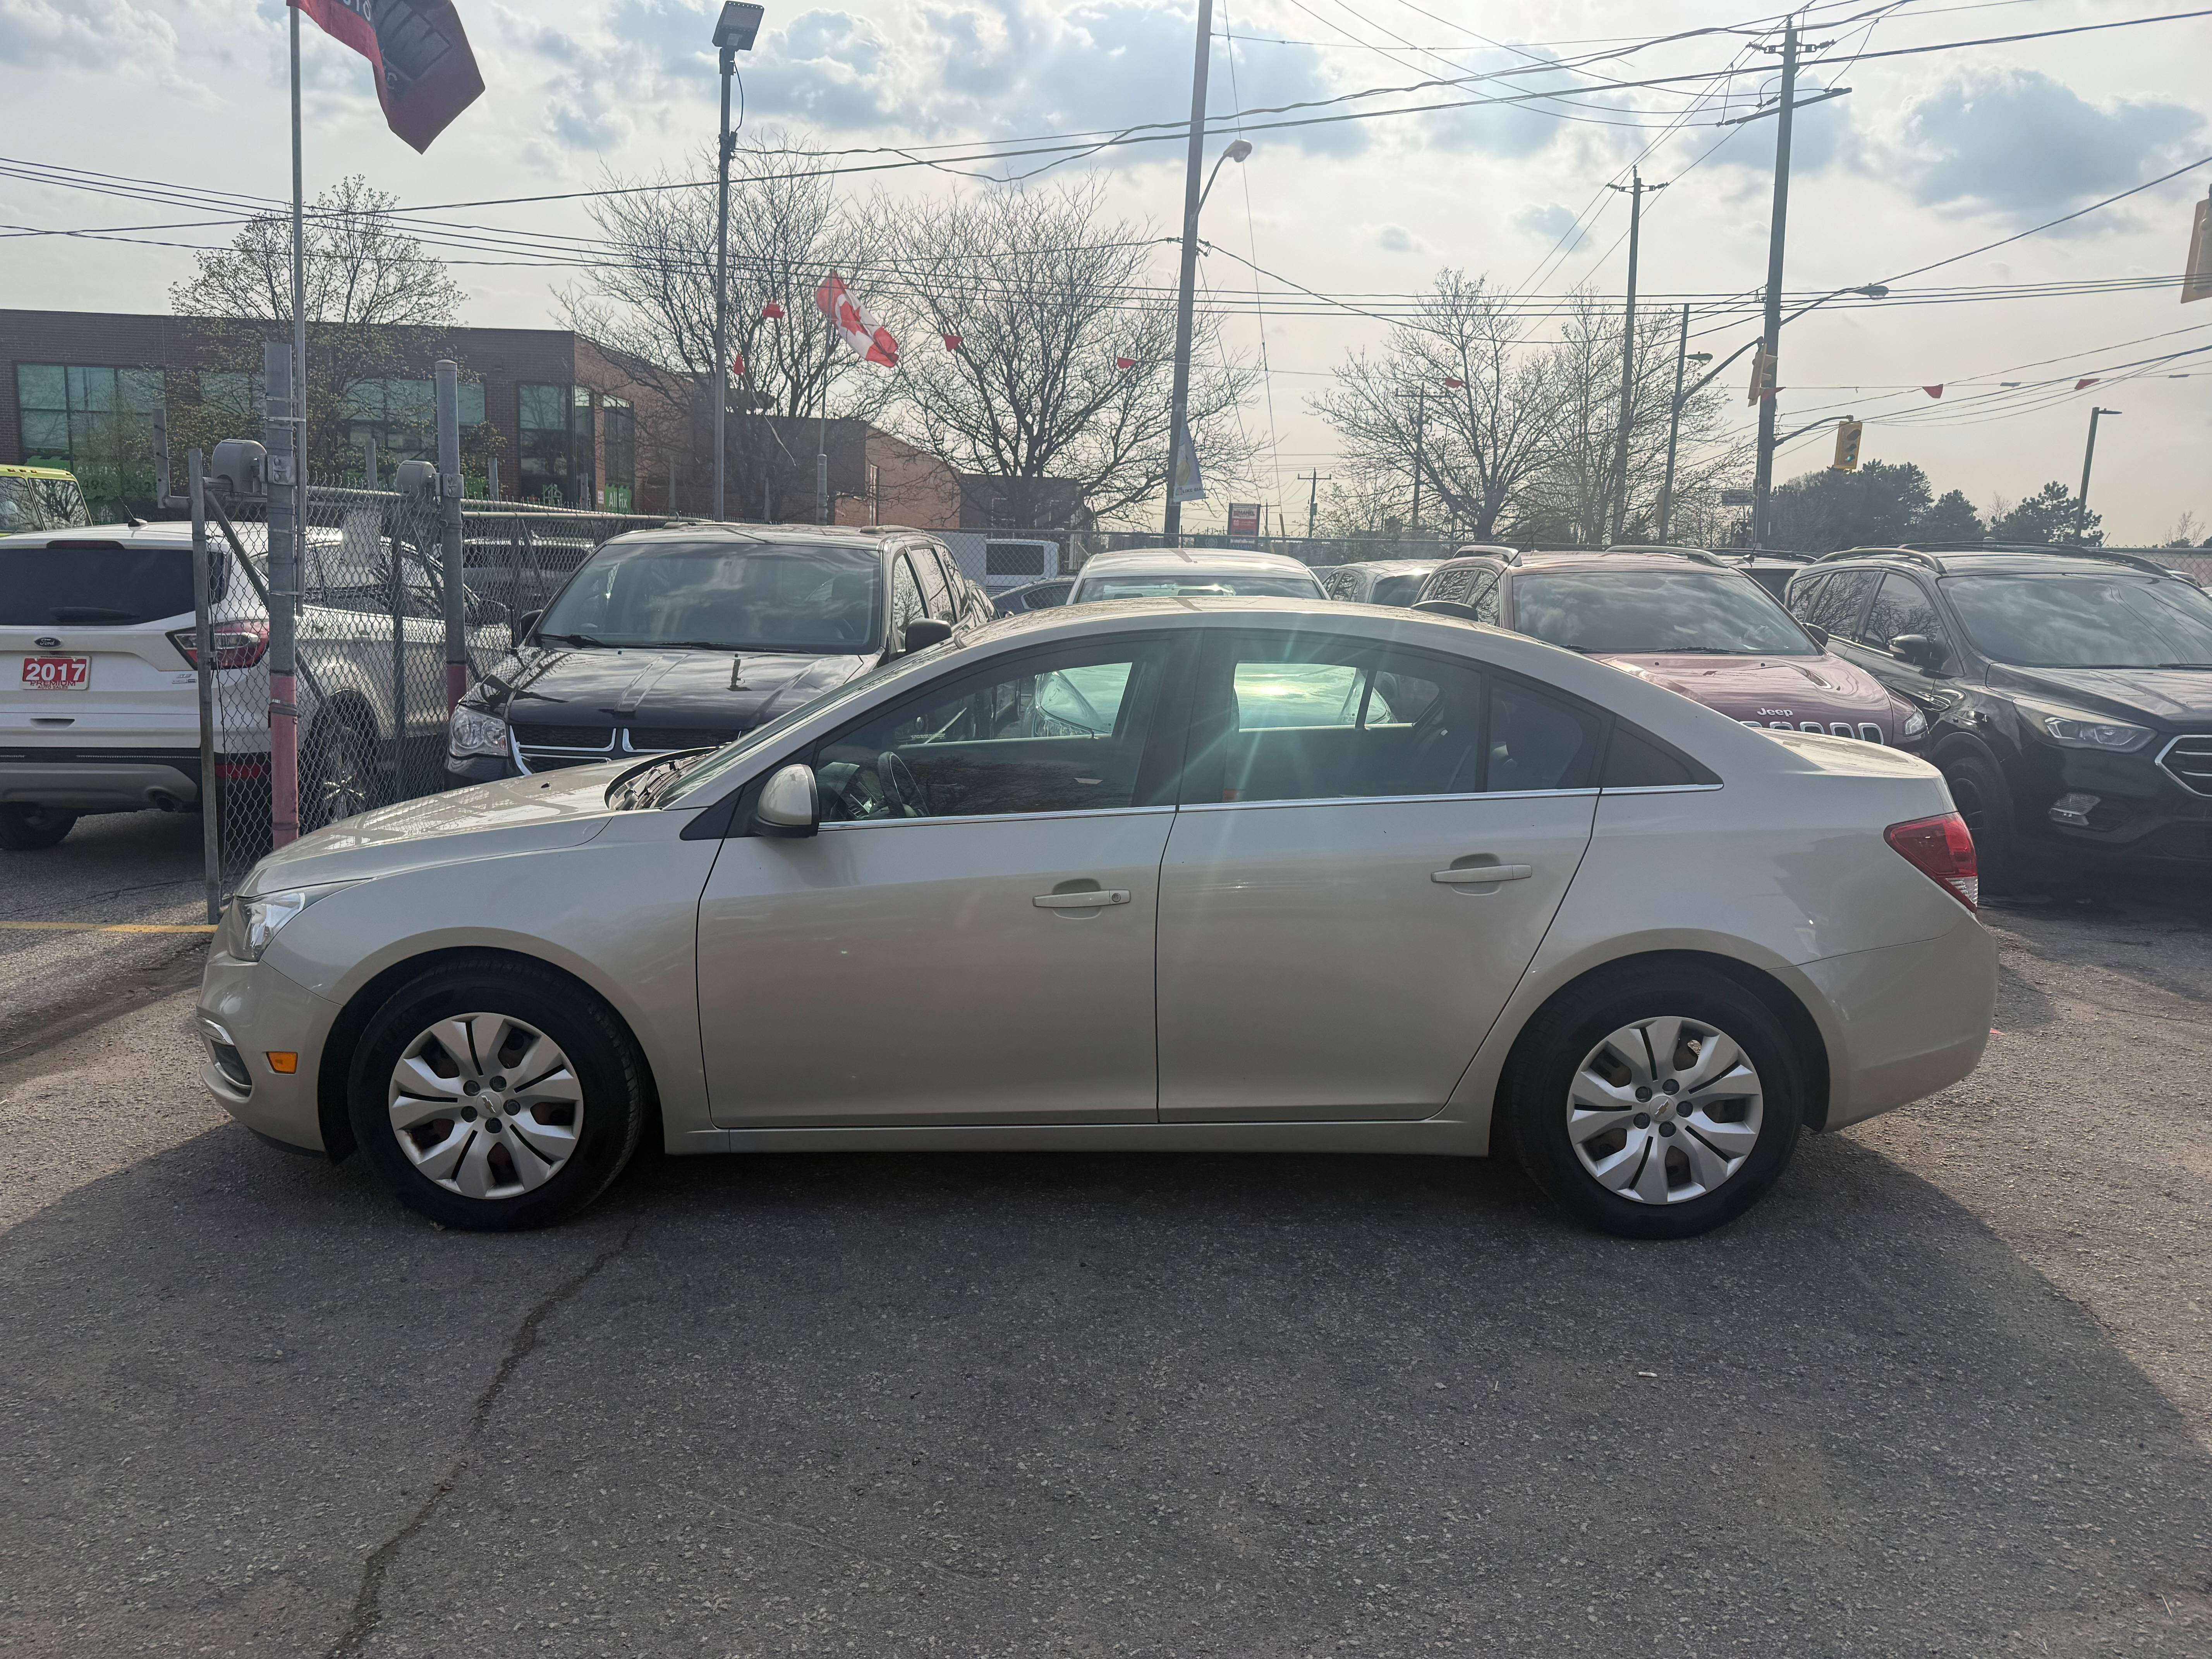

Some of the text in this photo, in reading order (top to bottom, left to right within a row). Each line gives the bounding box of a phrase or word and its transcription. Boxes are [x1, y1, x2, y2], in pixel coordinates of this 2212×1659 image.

[609, 491, 627, 508] All Fix
[26, 663, 86, 681] 2017
[1757, 708, 1793, 717] Jeep
